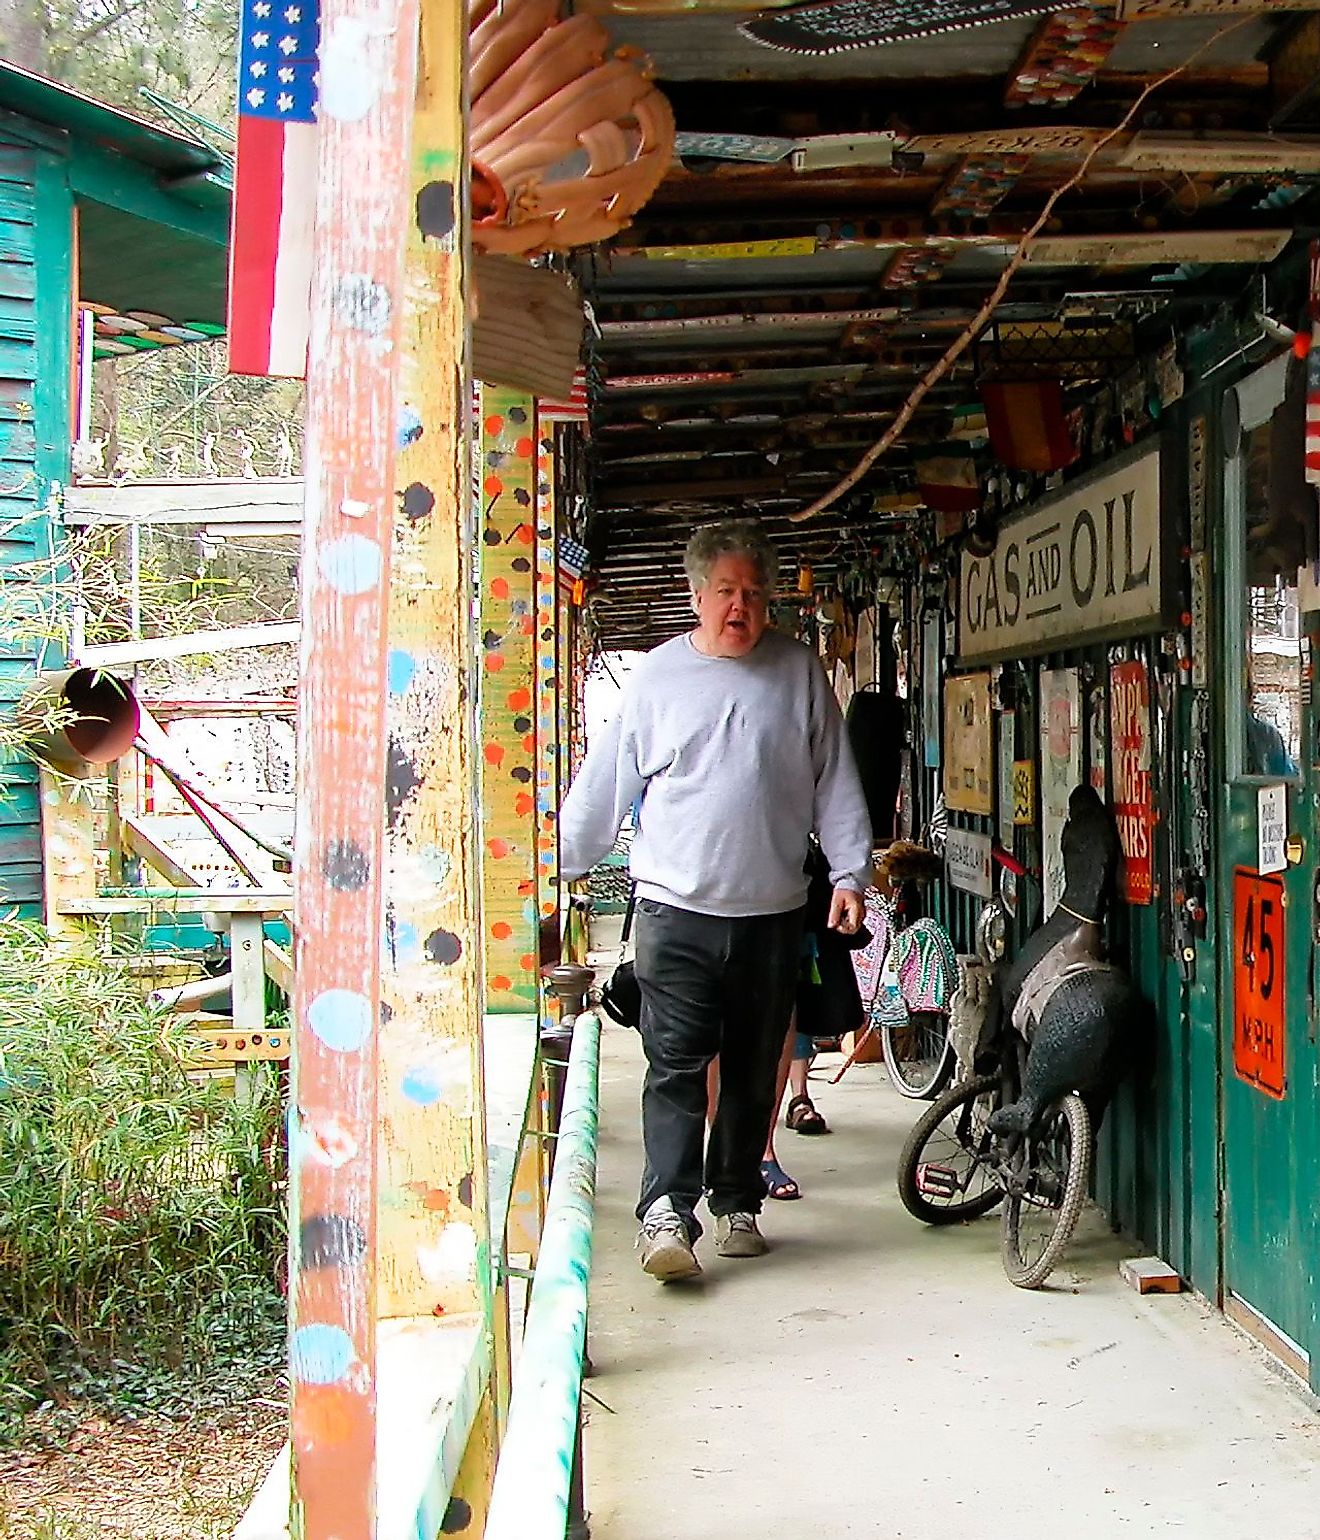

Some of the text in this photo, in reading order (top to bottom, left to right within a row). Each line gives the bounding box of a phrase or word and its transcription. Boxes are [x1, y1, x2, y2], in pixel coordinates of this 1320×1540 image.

[966, 542, 1021, 634] GAS
[1026, 543, 1062, 599] AND
[1070, 489, 1152, 608] OIL
[1242, 894, 1275, 1000] 45
